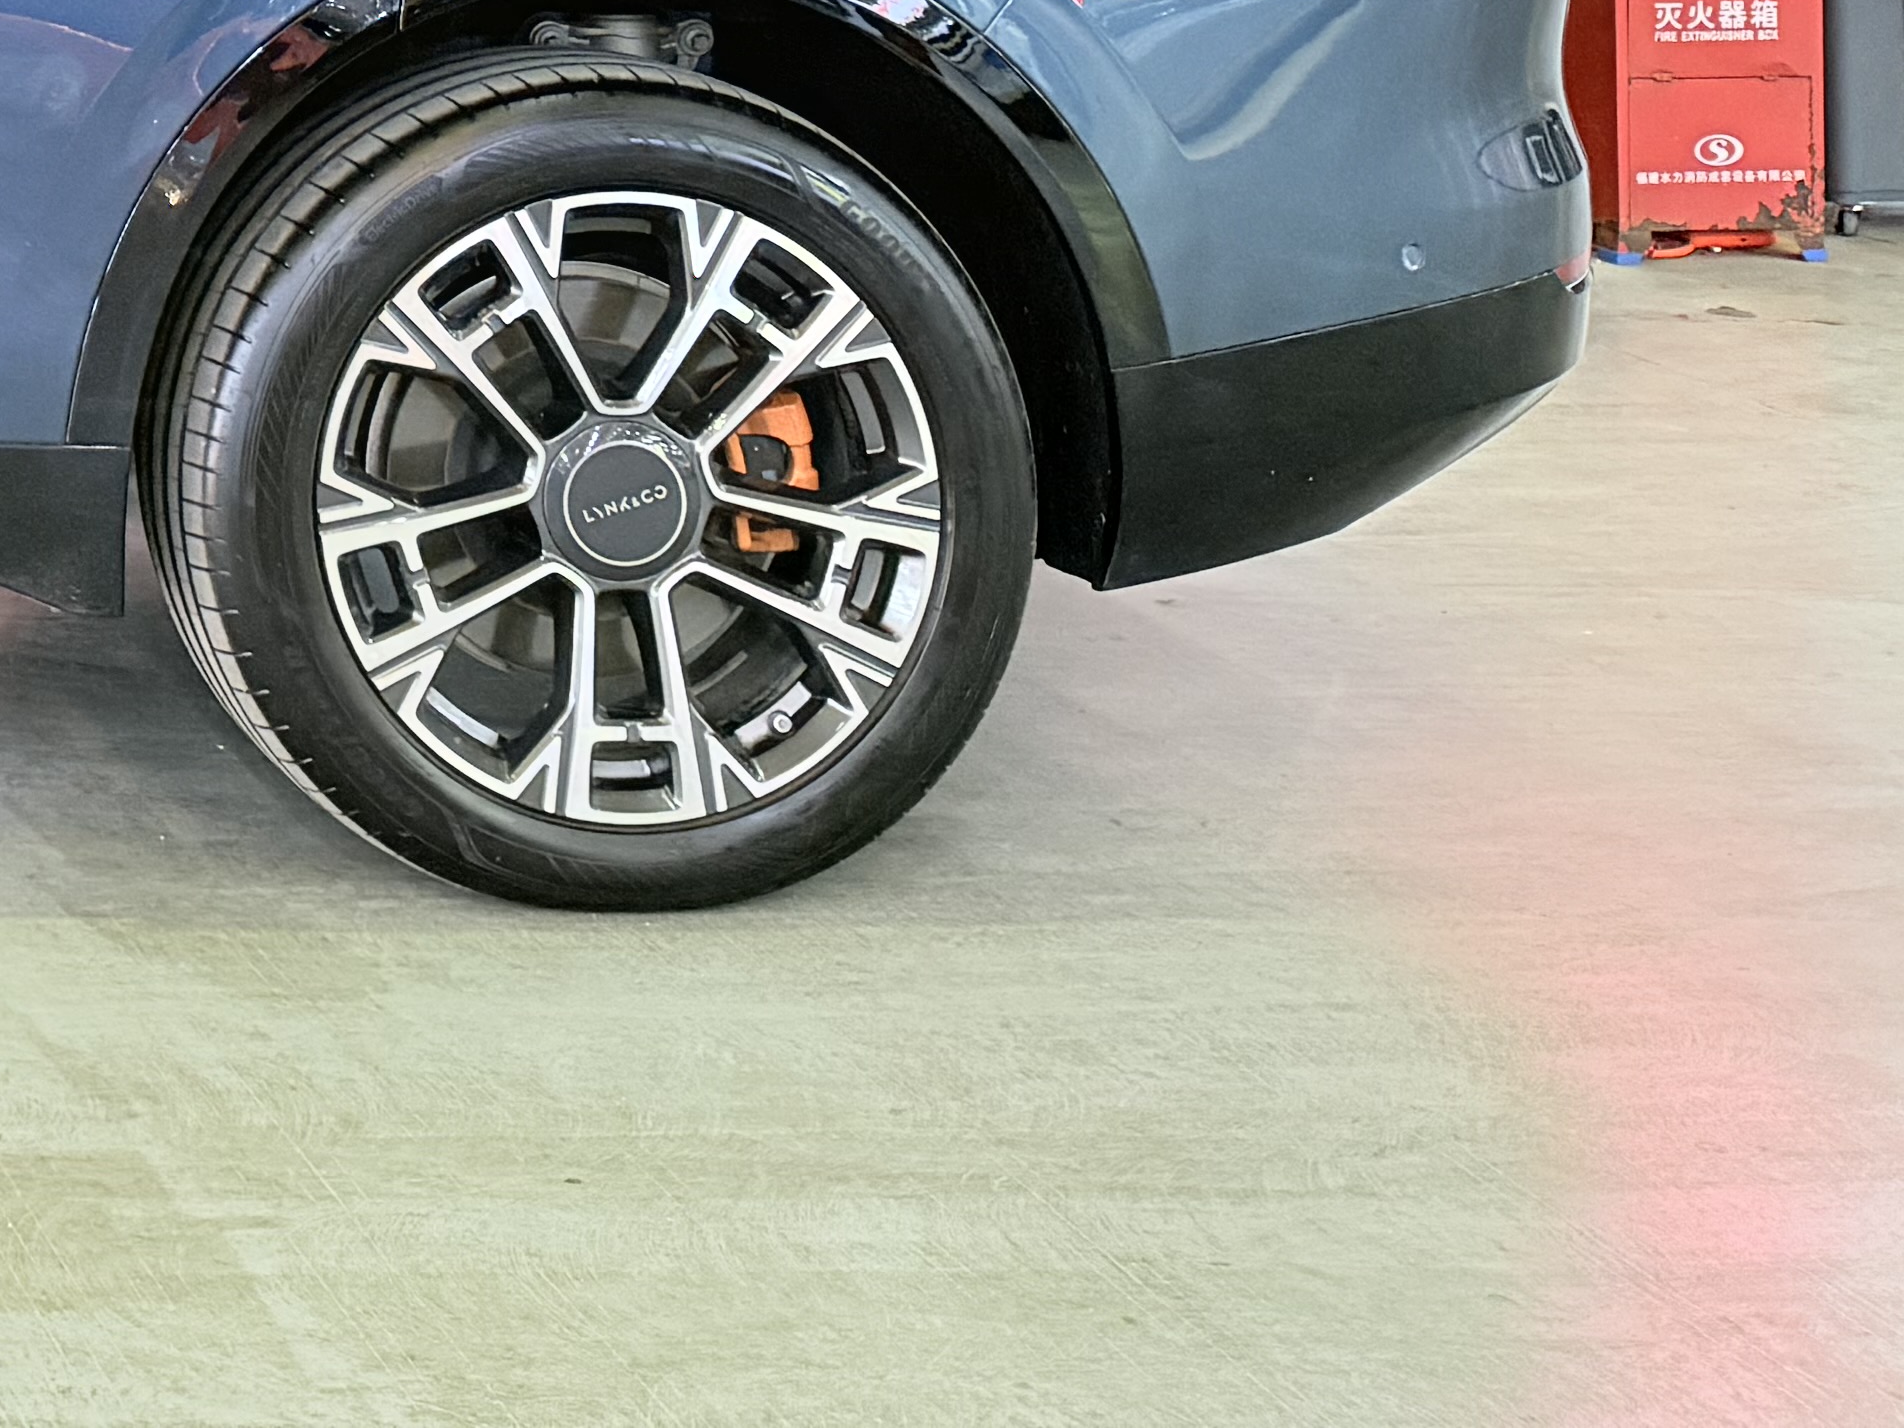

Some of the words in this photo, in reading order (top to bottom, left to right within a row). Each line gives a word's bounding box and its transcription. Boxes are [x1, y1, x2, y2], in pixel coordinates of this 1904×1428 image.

[1654, 0, 1779, 29] 灭火器箱
[1654, 30, 1678, 42] FIRE
[1681, 30, 1755, 42] EXTINGUISHER
[1757, 29, 1779, 41] BOX
